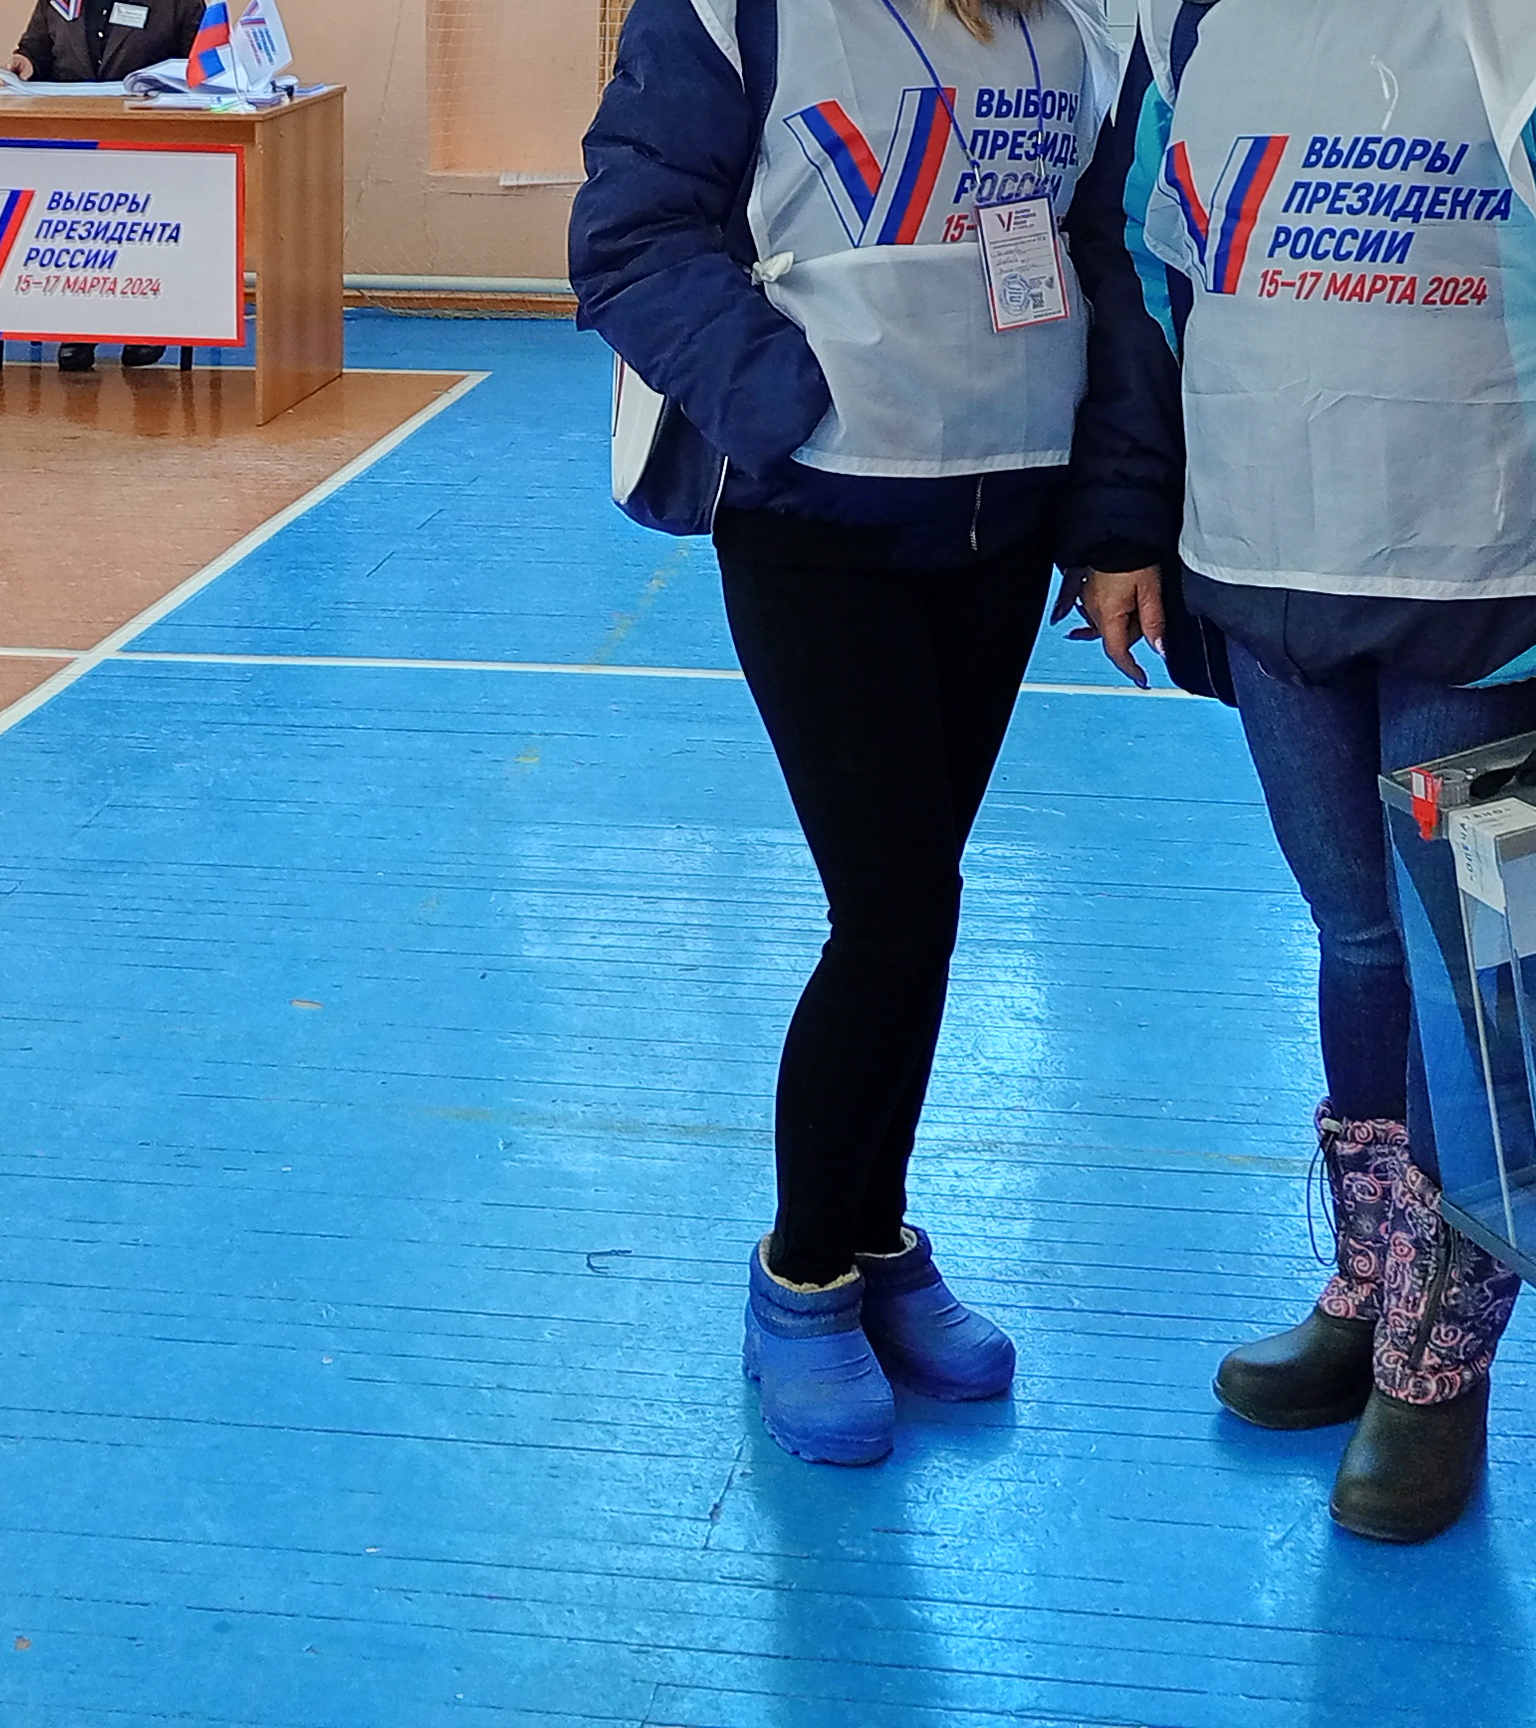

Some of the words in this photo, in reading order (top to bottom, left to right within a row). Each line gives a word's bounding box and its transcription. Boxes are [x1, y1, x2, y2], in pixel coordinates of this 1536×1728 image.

[969, 129, 1079, 169] ПРЕЗИДЕ
[1301, 135, 1469, 175] ВЫБОРЫ
[47, 191, 151, 213] ВЫБОРЫ
[1282, 181, 1512, 223] ПРЕЗИДЕНТА
[35, 219, 181, 243] ПРЕЗИДЕНТА
[1267, 226, 1415, 264] РОССИИ
[23, 248, 118, 269] РОССИИ
[63, 277, 118, 295] МАРТА
[120, 277, 161, 296] 2024
[1323, 272, 1416, 305] МАРТА
[1420, 276, 1488, 306] 2024
